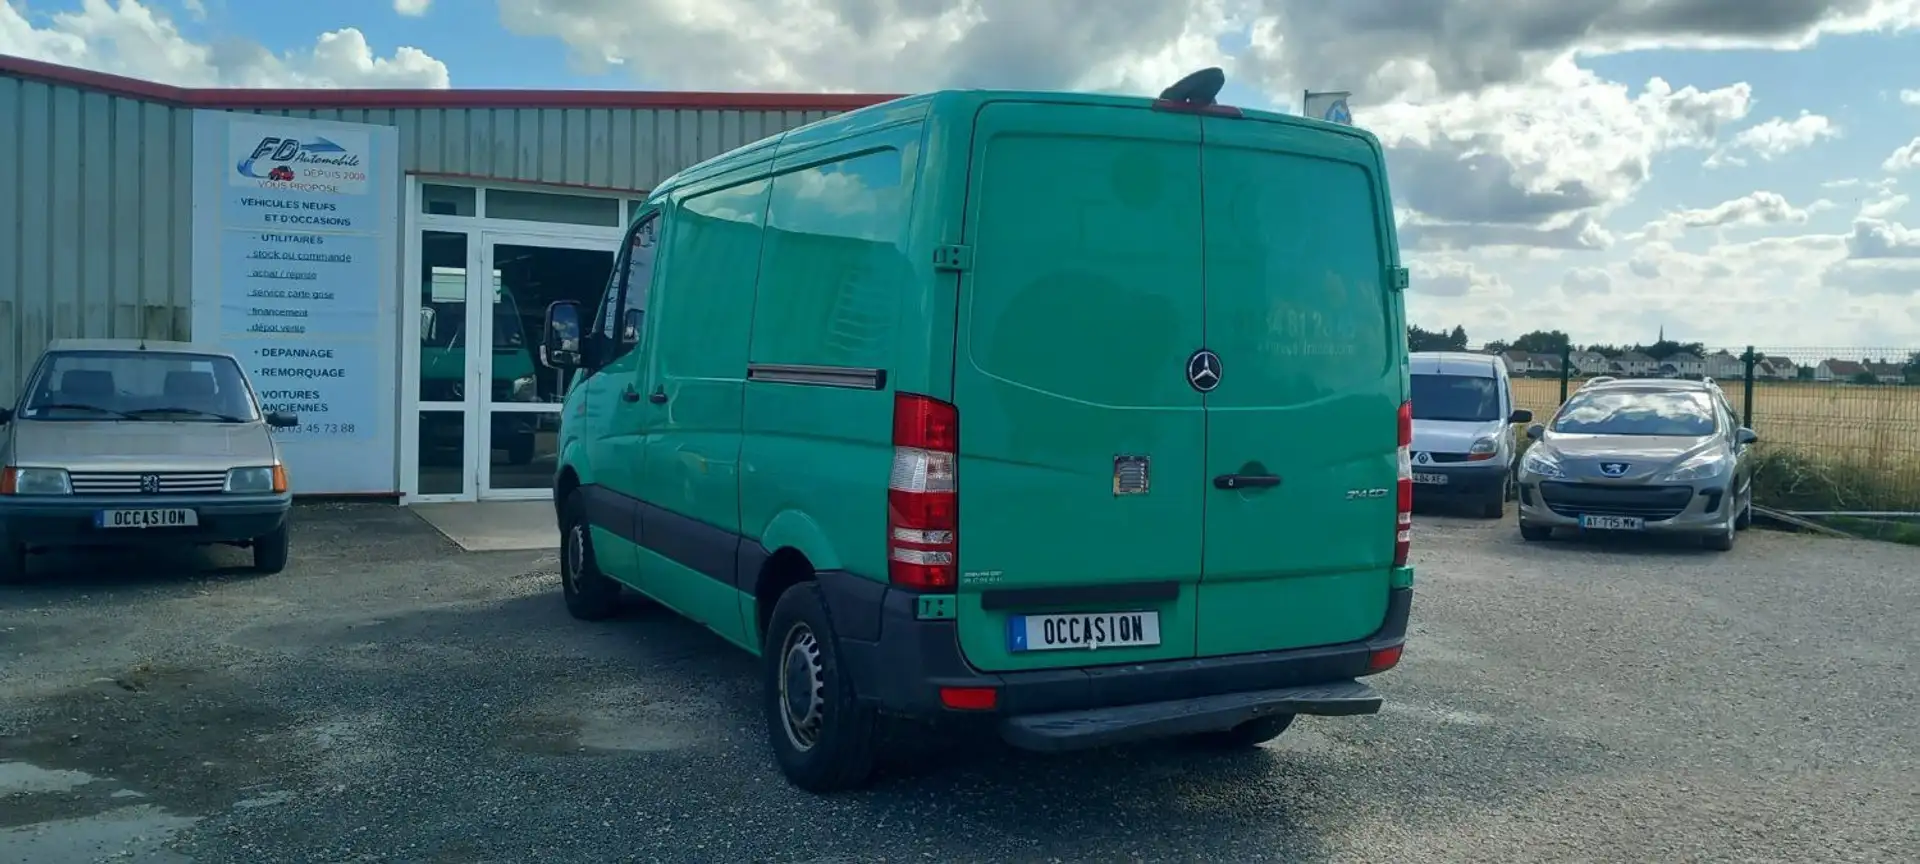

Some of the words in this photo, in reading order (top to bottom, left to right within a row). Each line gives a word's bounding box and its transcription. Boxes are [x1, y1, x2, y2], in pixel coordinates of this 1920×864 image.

[303, 168, 341, 179] DEPUIS
[258, 180, 287, 189] VOUS
[290, 182, 340, 193] PROPOSE
[241, 198, 299, 209] VEHICULES
[302, 202, 337, 212] NEUFS
[264, 213, 278, 223] ET
[261, 234, 324, 245] UTILITAIRES
[252, 249, 280, 260] stock
[282, 252, 295, 261] ou
[297, 252, 352, 263] commande
[252, 307, 308, 318] financement
[261, 348, 334, 358] DEPANNAGE
[261, 367, 346, 379] REMORQUAGE
[261, 390, 320, 400] VOITURES
[261, 402, 329, 413] ANCIENNES
[114, 510, 186, 525] OCCASION
[1043, 615, 1143, 645] OCCASION
